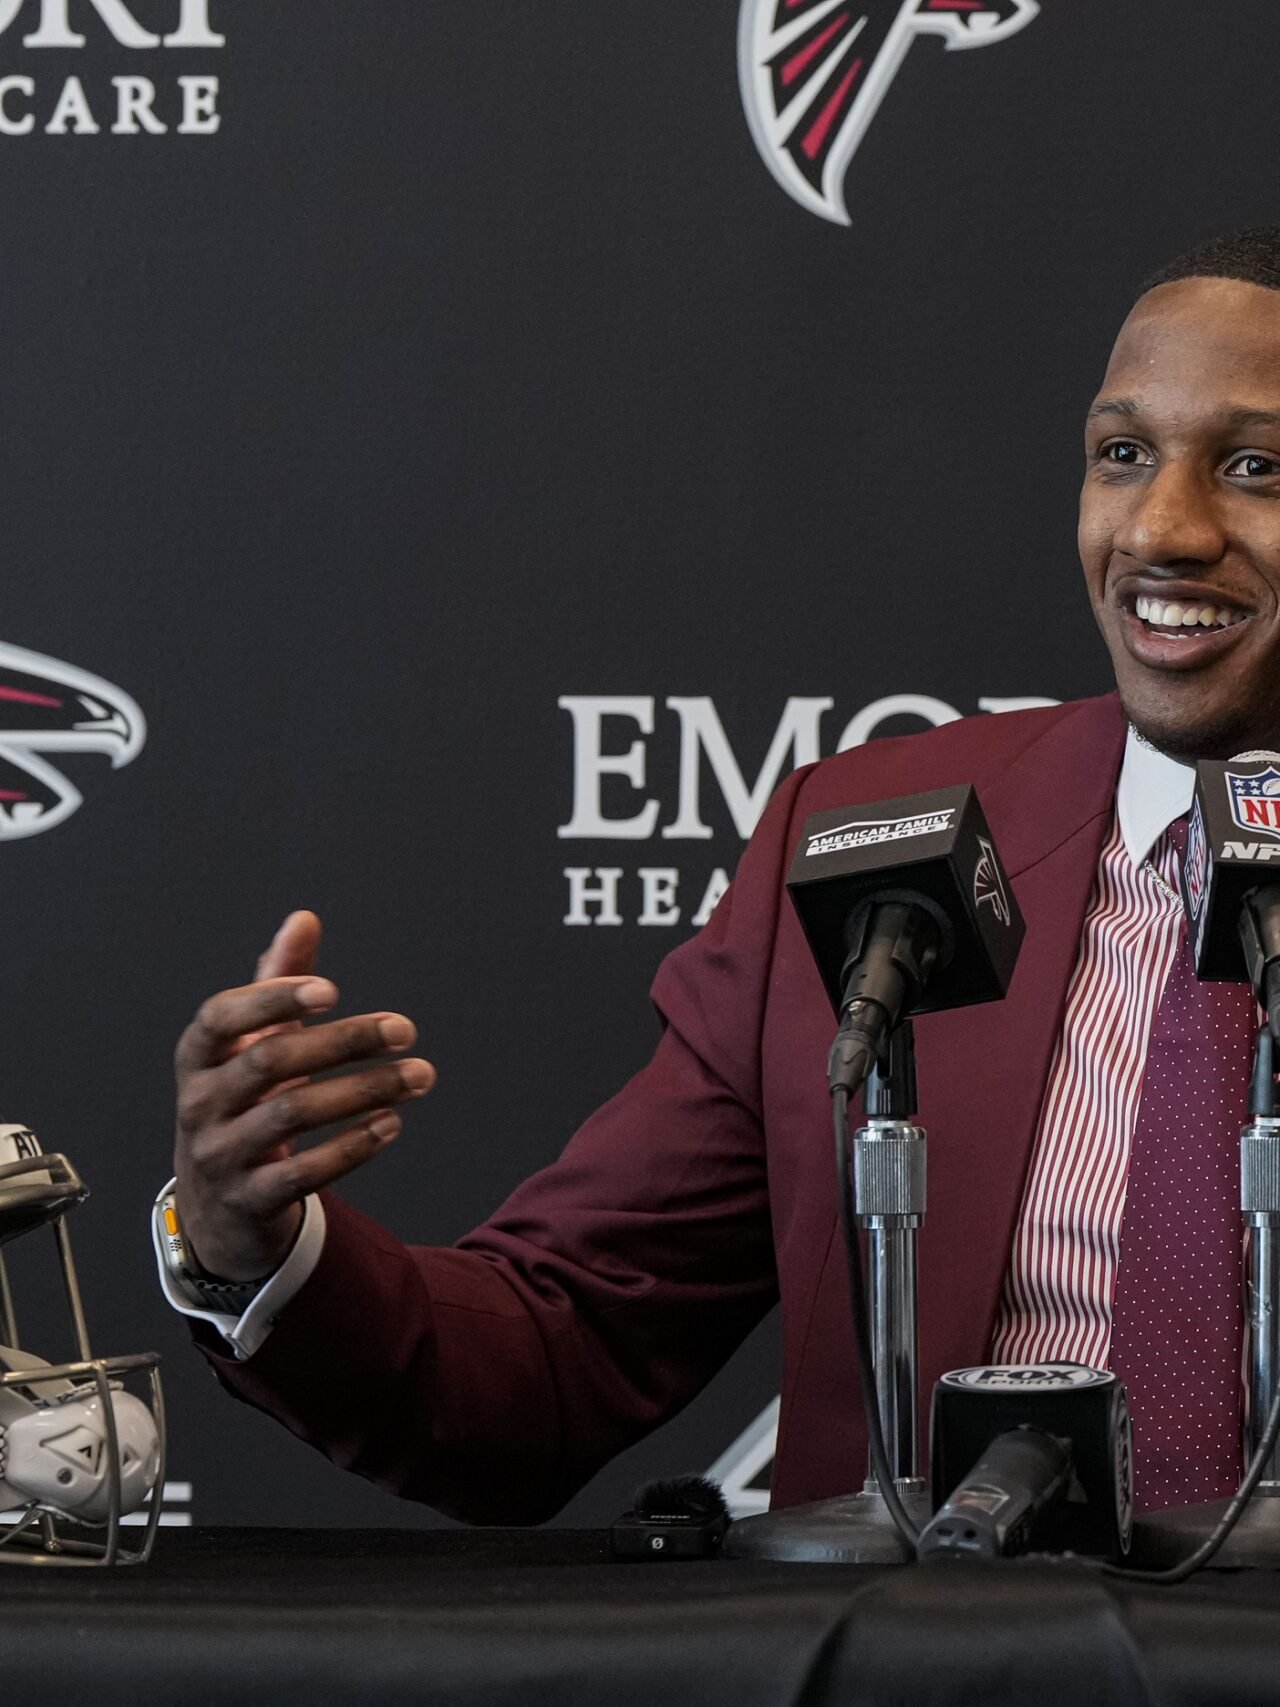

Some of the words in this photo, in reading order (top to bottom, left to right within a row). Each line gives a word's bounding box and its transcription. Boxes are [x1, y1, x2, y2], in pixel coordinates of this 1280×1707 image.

[809, 825, 890, 848] AMERICAN
[894, 814, 951, 832] FAMILY
[818, 826, 935, 851] INSURANCE
[979, 1370, 1078, 1380] FOX
